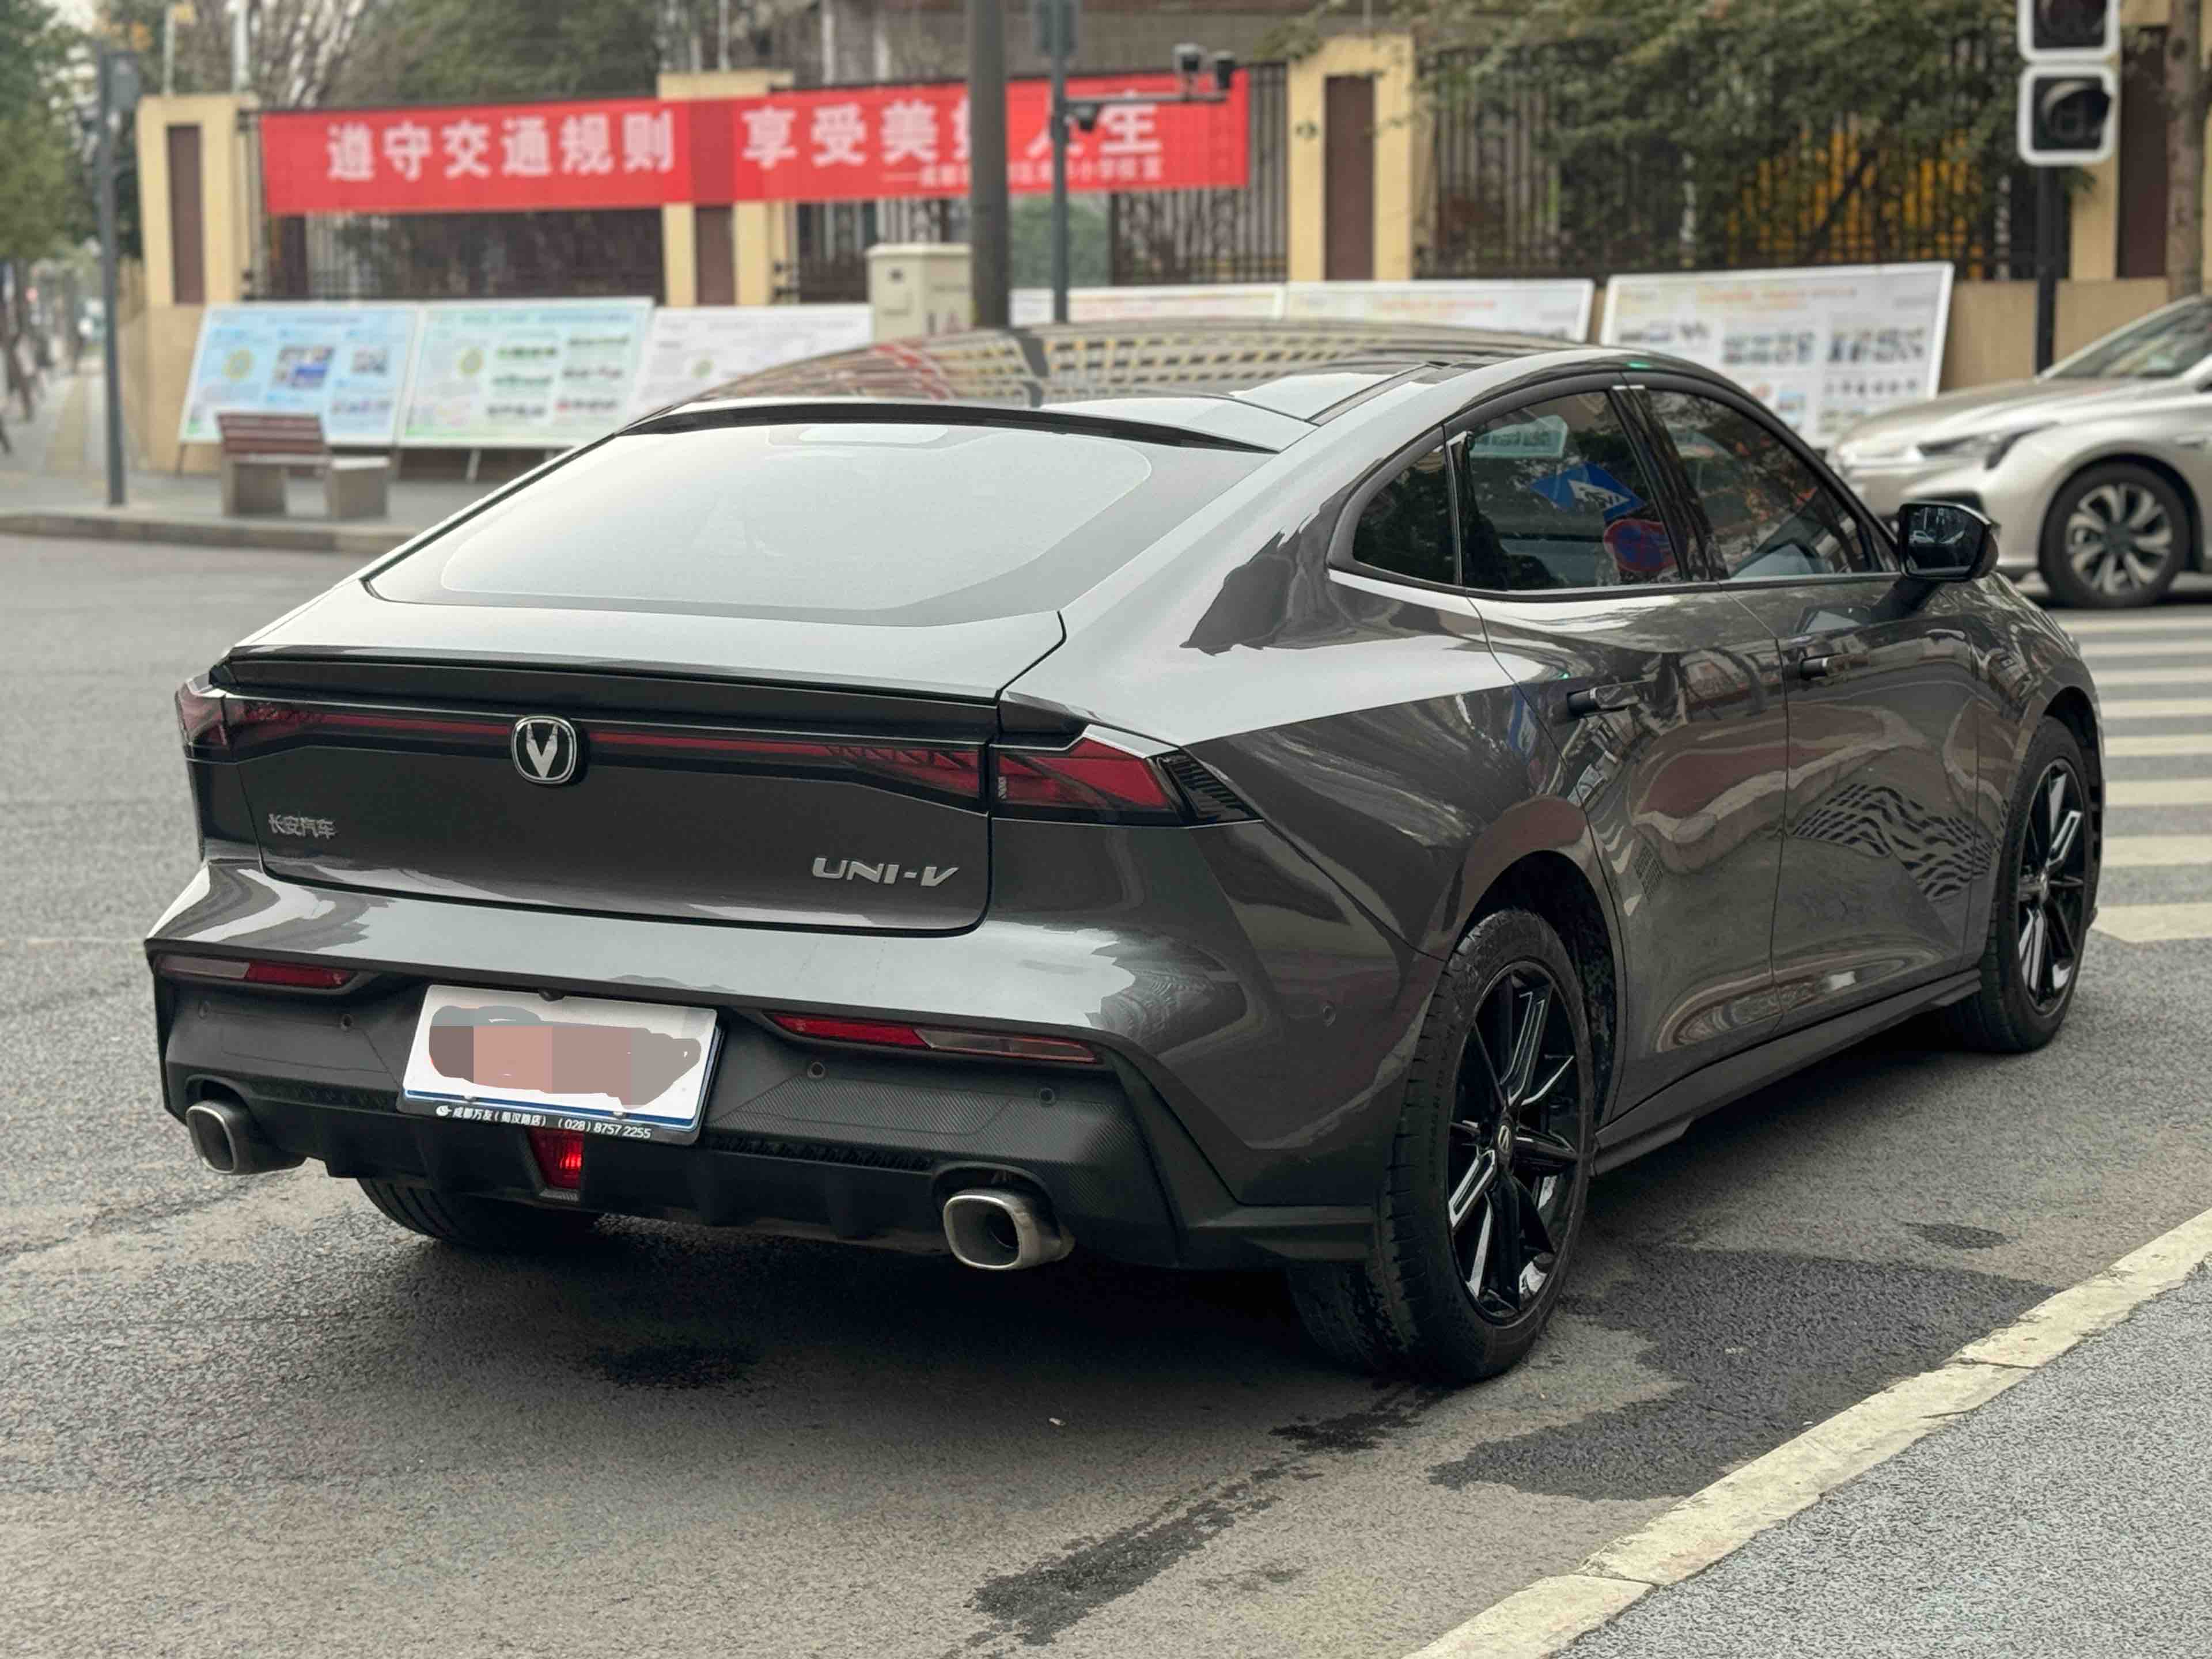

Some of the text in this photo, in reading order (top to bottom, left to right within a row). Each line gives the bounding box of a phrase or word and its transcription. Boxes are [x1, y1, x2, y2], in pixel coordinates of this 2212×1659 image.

[327, 91, 1161, 181] 遵守交通规则 享受美人生
[268, 813, 337, 839] 长安汽车
[812, 857, 959, 887] UNI-V
[558, 1118, 592, 1132] (028)
[623, 1126, 652, 1139] 2255
